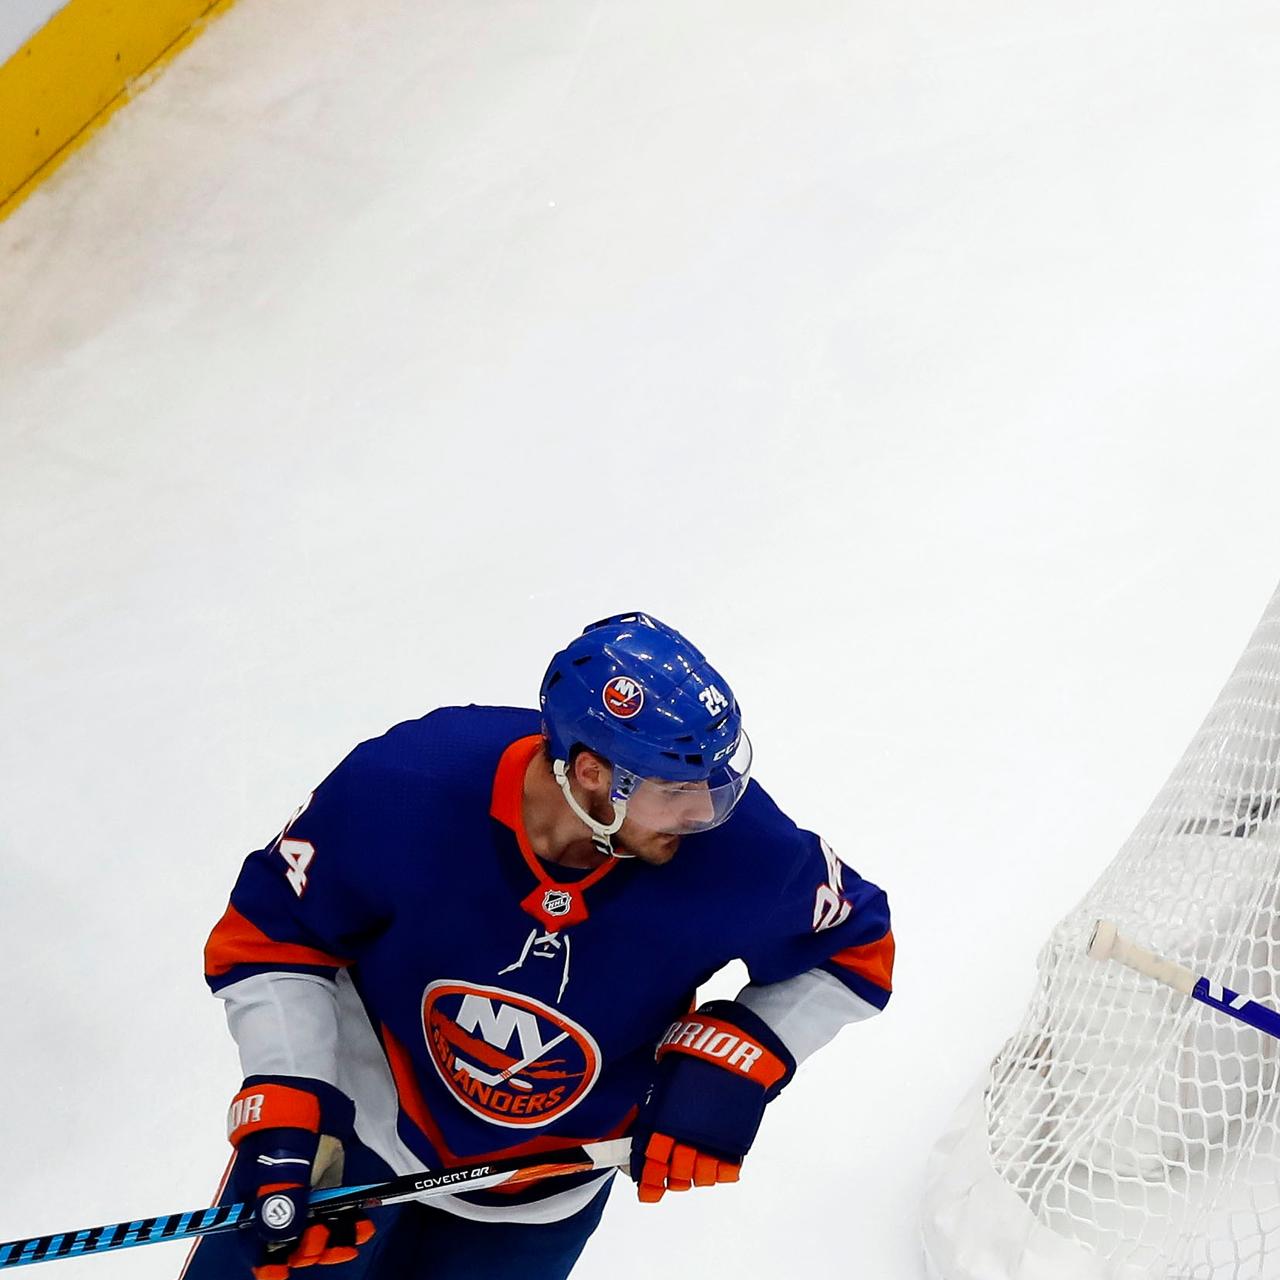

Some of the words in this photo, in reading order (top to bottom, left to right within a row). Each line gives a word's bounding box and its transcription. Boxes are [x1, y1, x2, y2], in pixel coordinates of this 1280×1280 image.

[699, 684, 729, 717] 24
[713, 737, 741, 761] CC
[655, 1020, 763, 1074] RRIOR
[432, 1028, 567, 1115] ISLANDERS
[414, 1171, 468, 1191] COVERT
